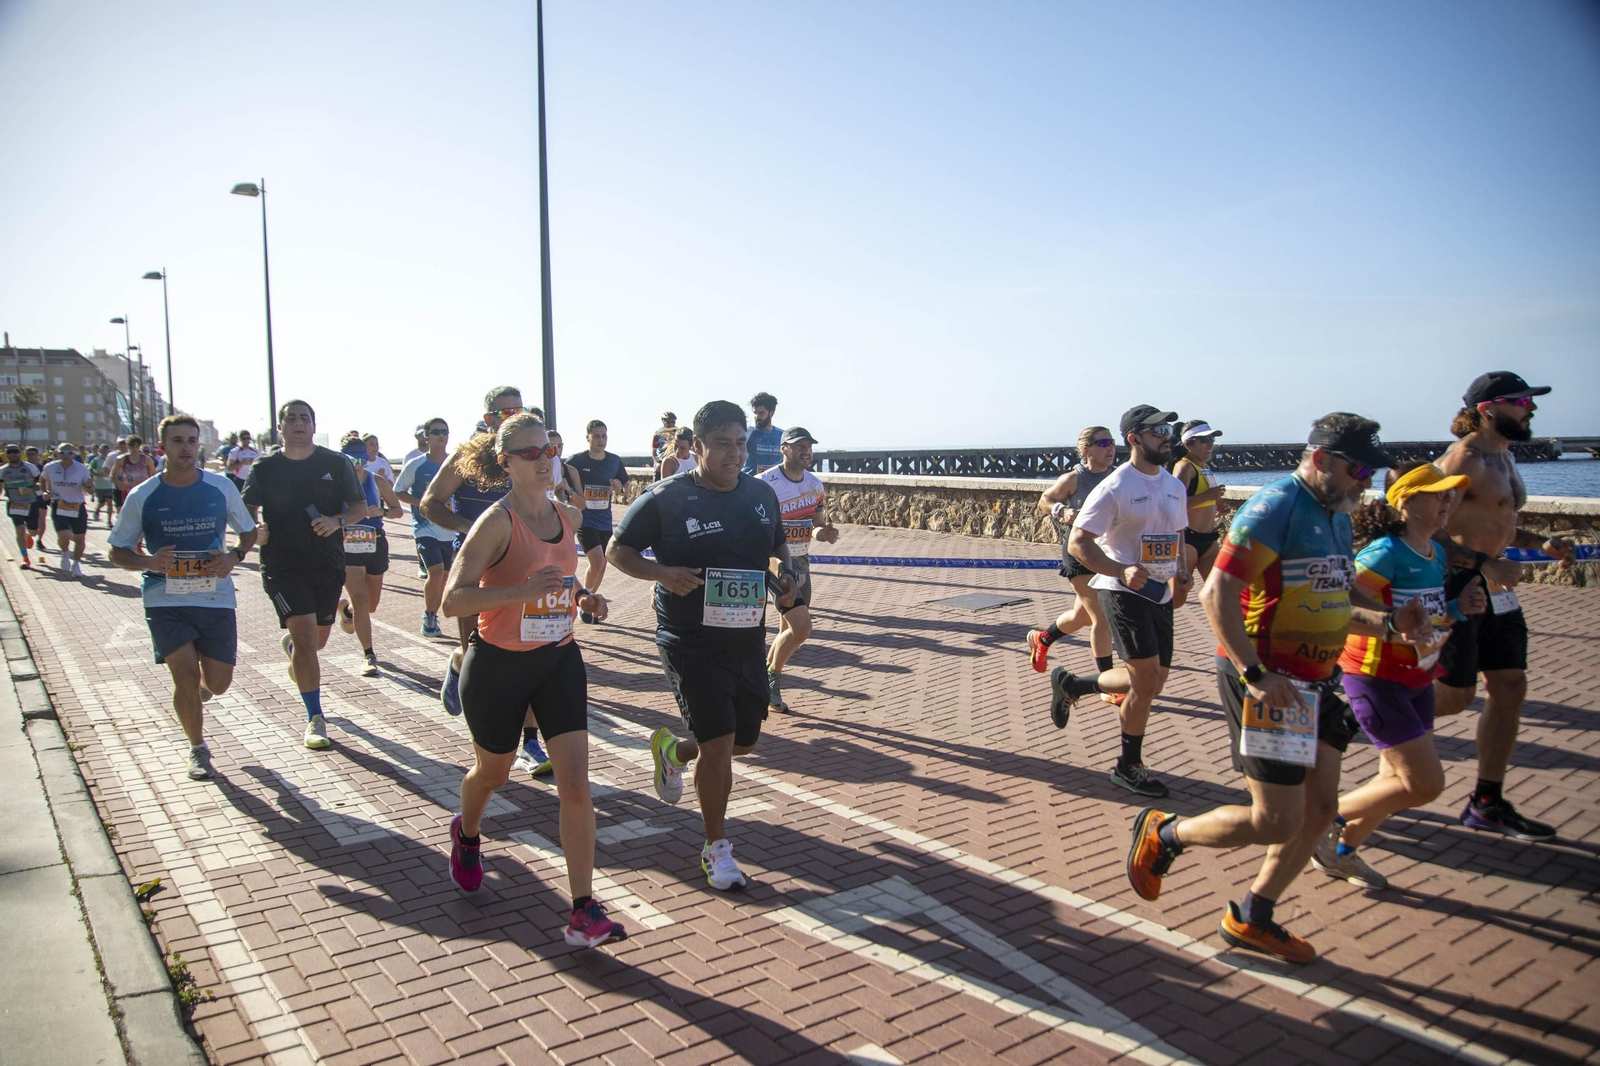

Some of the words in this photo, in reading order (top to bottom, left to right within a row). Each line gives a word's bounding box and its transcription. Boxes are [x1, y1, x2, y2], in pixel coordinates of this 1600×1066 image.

[195, 522, 216, 530] 2025
[702, 520, 722, 530] LCH
[346, 530, 372, 540] 2401
[785, 528, 810, 538] 2003
[1146, 543, 1172, 556] 188
[1315, 576, 1344, 589] TEAM
[714, 580, 758, 599] 1651
[1252, 700, 1310, 726] 1658
